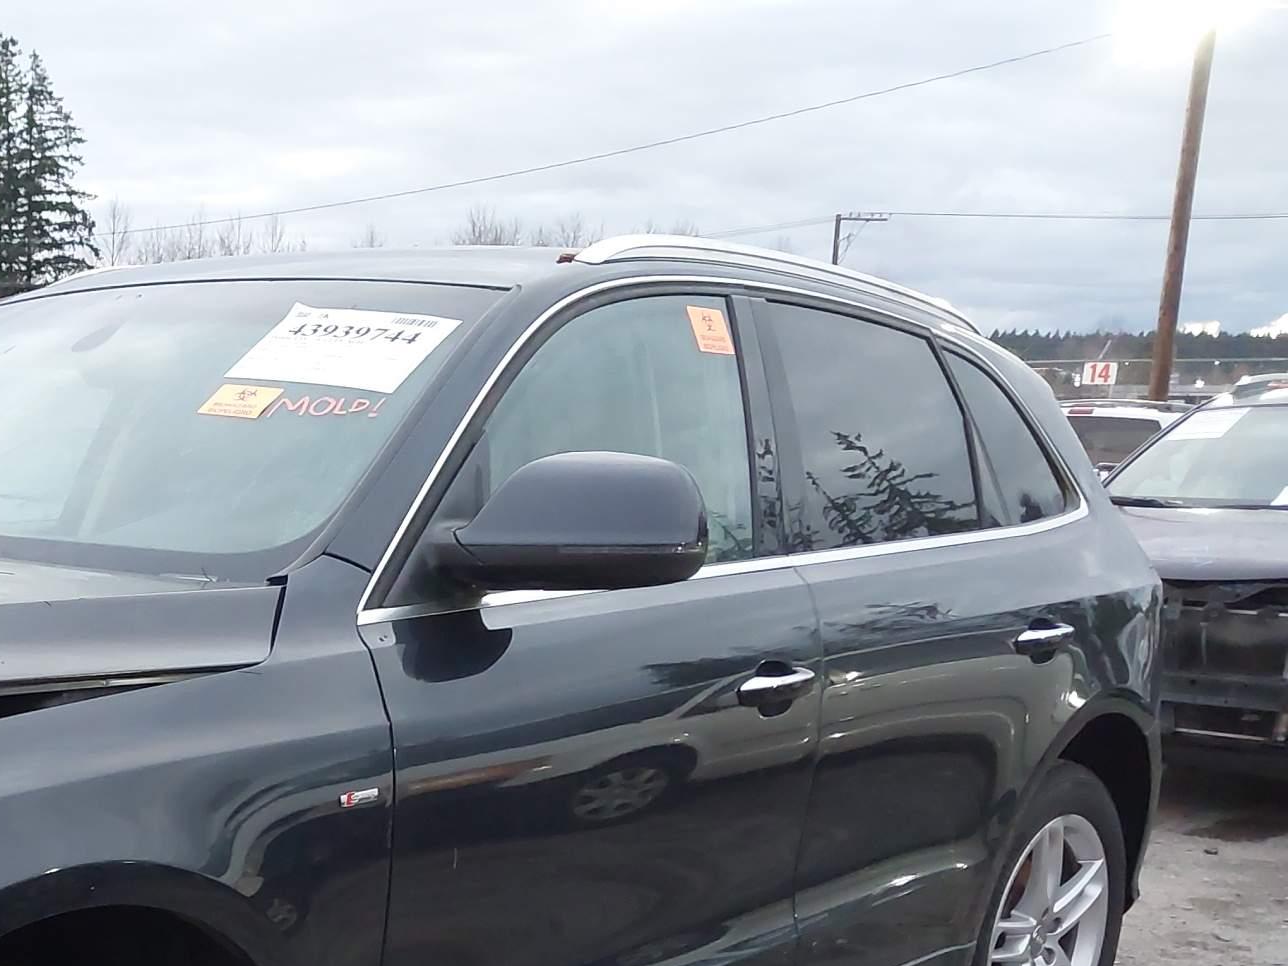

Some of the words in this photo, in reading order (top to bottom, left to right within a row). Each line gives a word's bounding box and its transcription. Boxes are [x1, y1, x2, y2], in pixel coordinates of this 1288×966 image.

[288, 323, 422, 344] 43939744
[1089, 362, 1111, 383] 14
[267, 395, 386, 417] MOLD!
